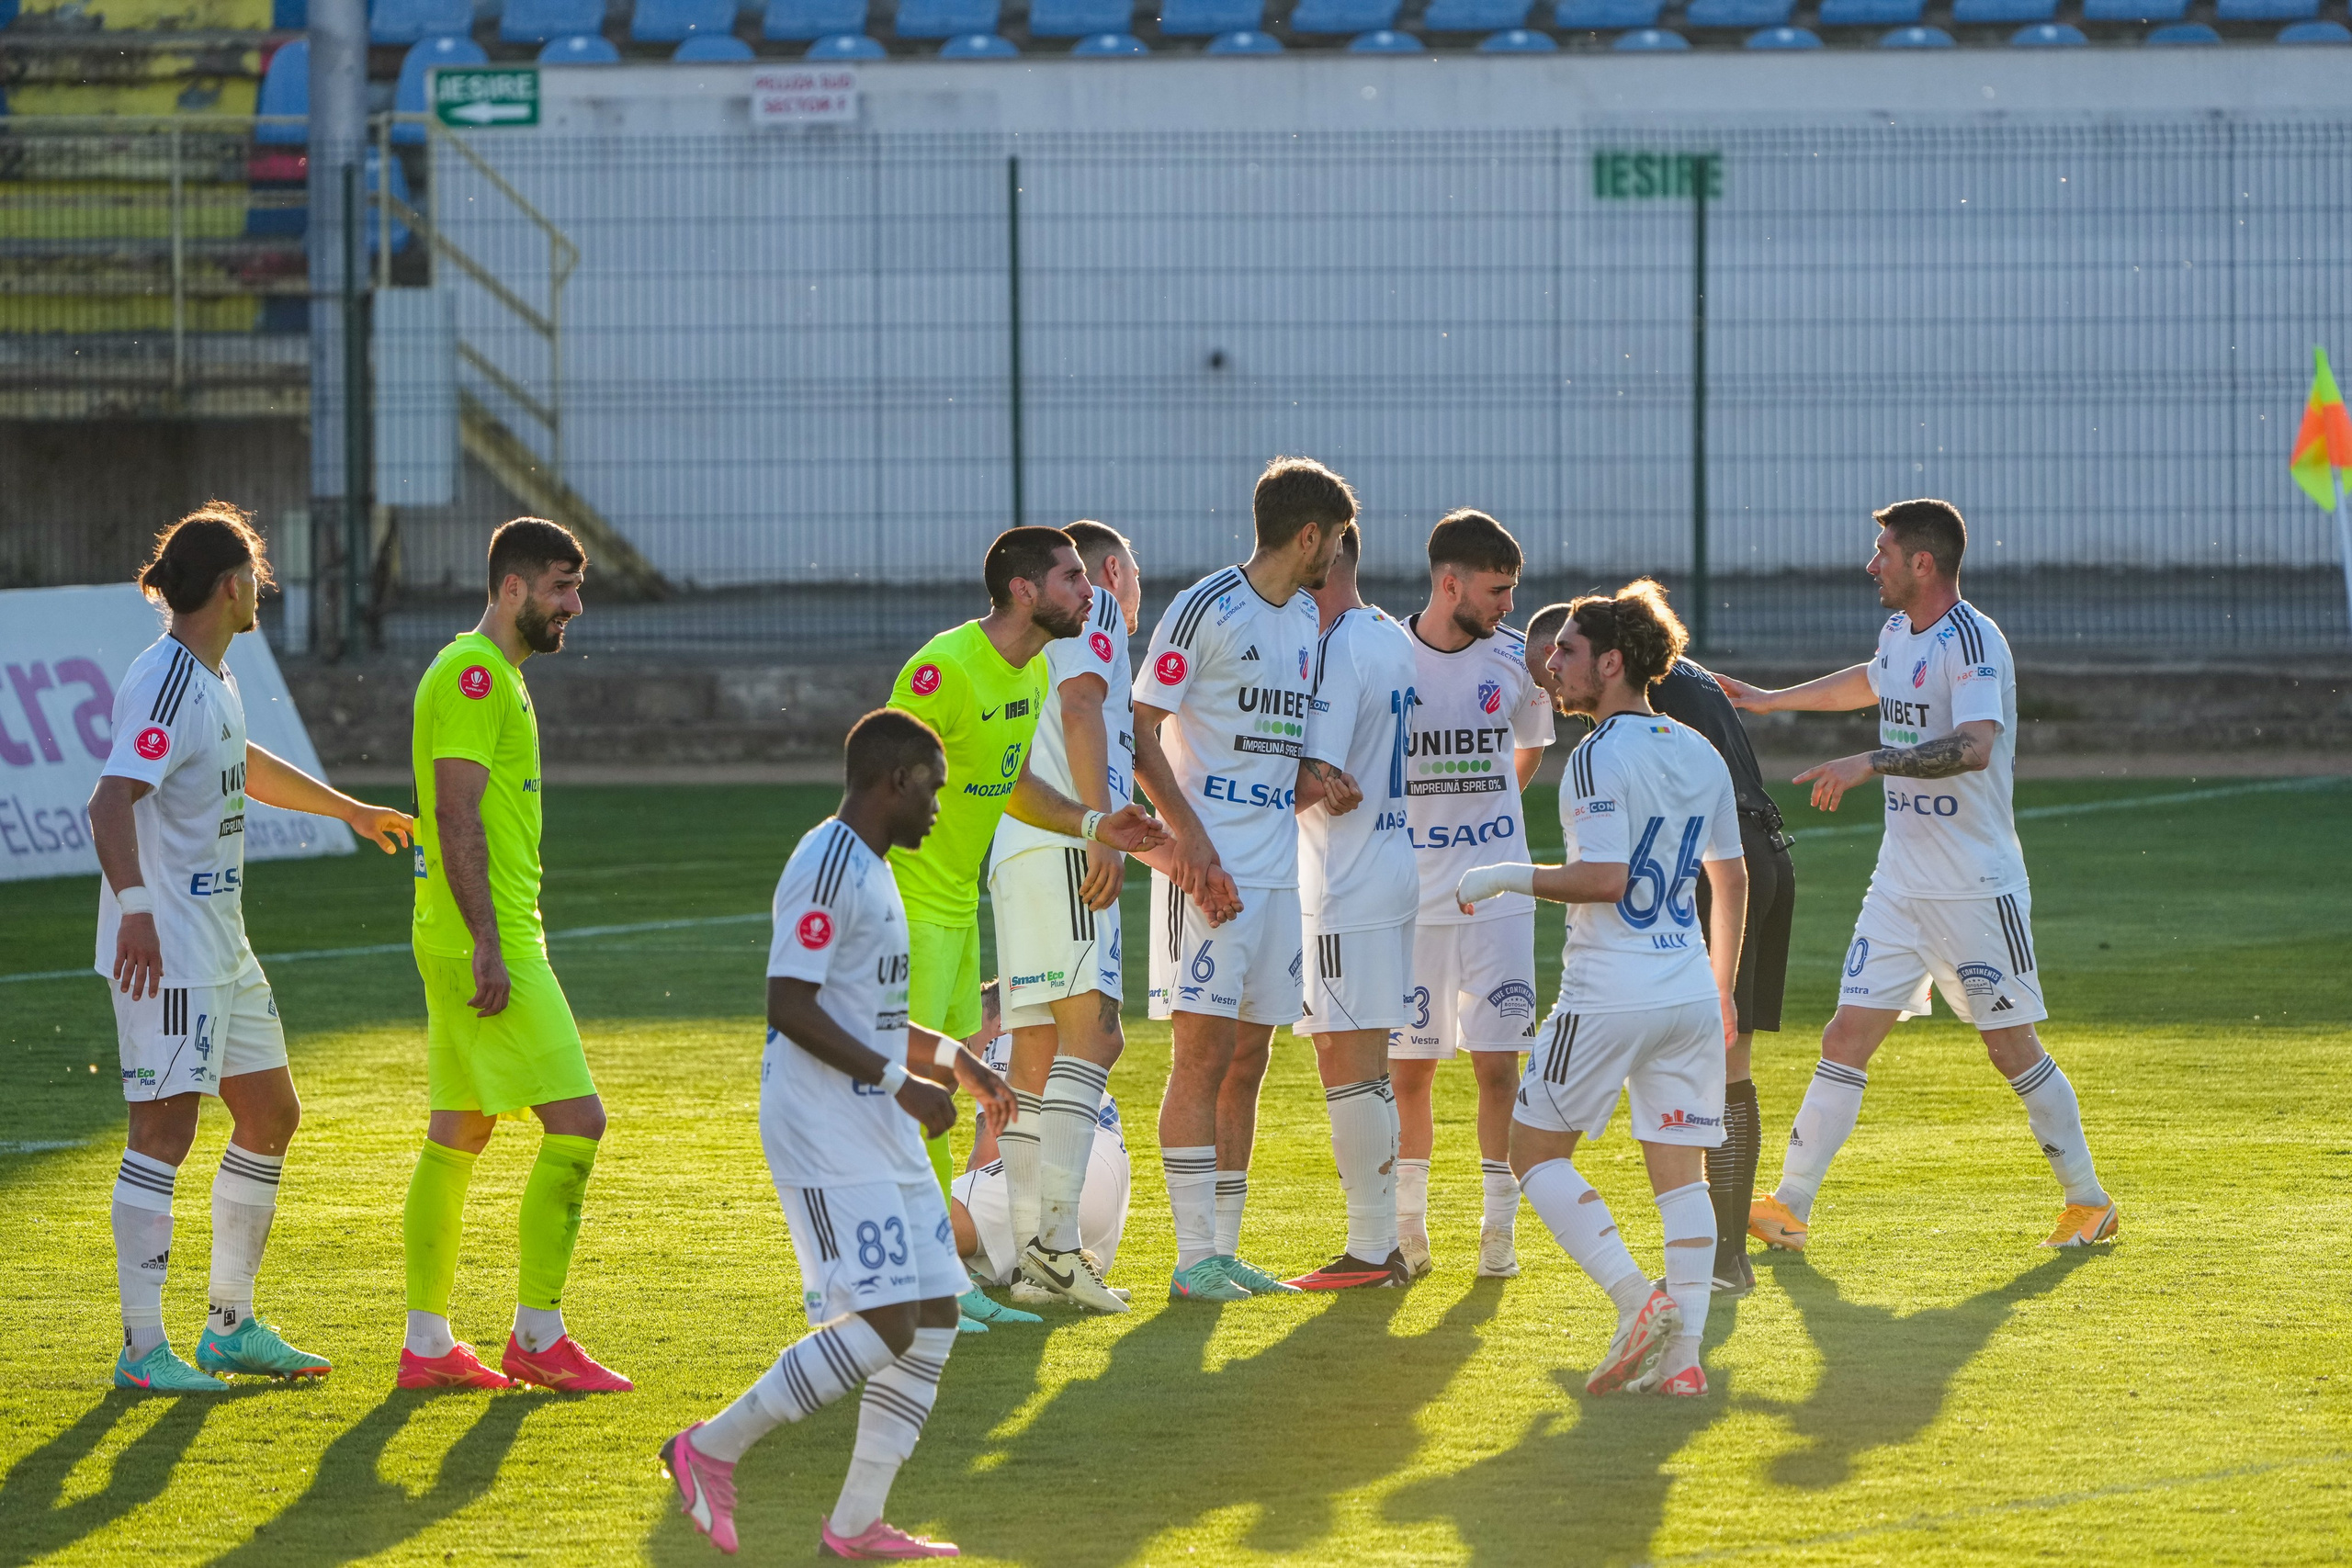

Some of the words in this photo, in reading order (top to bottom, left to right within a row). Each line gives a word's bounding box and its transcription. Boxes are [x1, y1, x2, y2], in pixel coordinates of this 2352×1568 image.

[1409, 778, 1461, 795] ÎMPREUNĂ
[1462, 778, 1487, 793] SPRE
[1616, 816, 1705, 930] 66
[1191, 939, 1216, 984] 6
[1012, 972, 1046, 987] Smart
[1047, 970, 1065, 982] Eco
[1050, 979, 1066, 988] Plus
[1211, 993, 1237, 1006] Vestra
[1410, 1035, 1440, 1045] Vestra
[137, 1067, 156, 1078] Eco
[140, 1077, 156, 1087] Plus
[1684, 1112, 1721, 1127] Smart
[856, 1215, 909, 1270] 83
